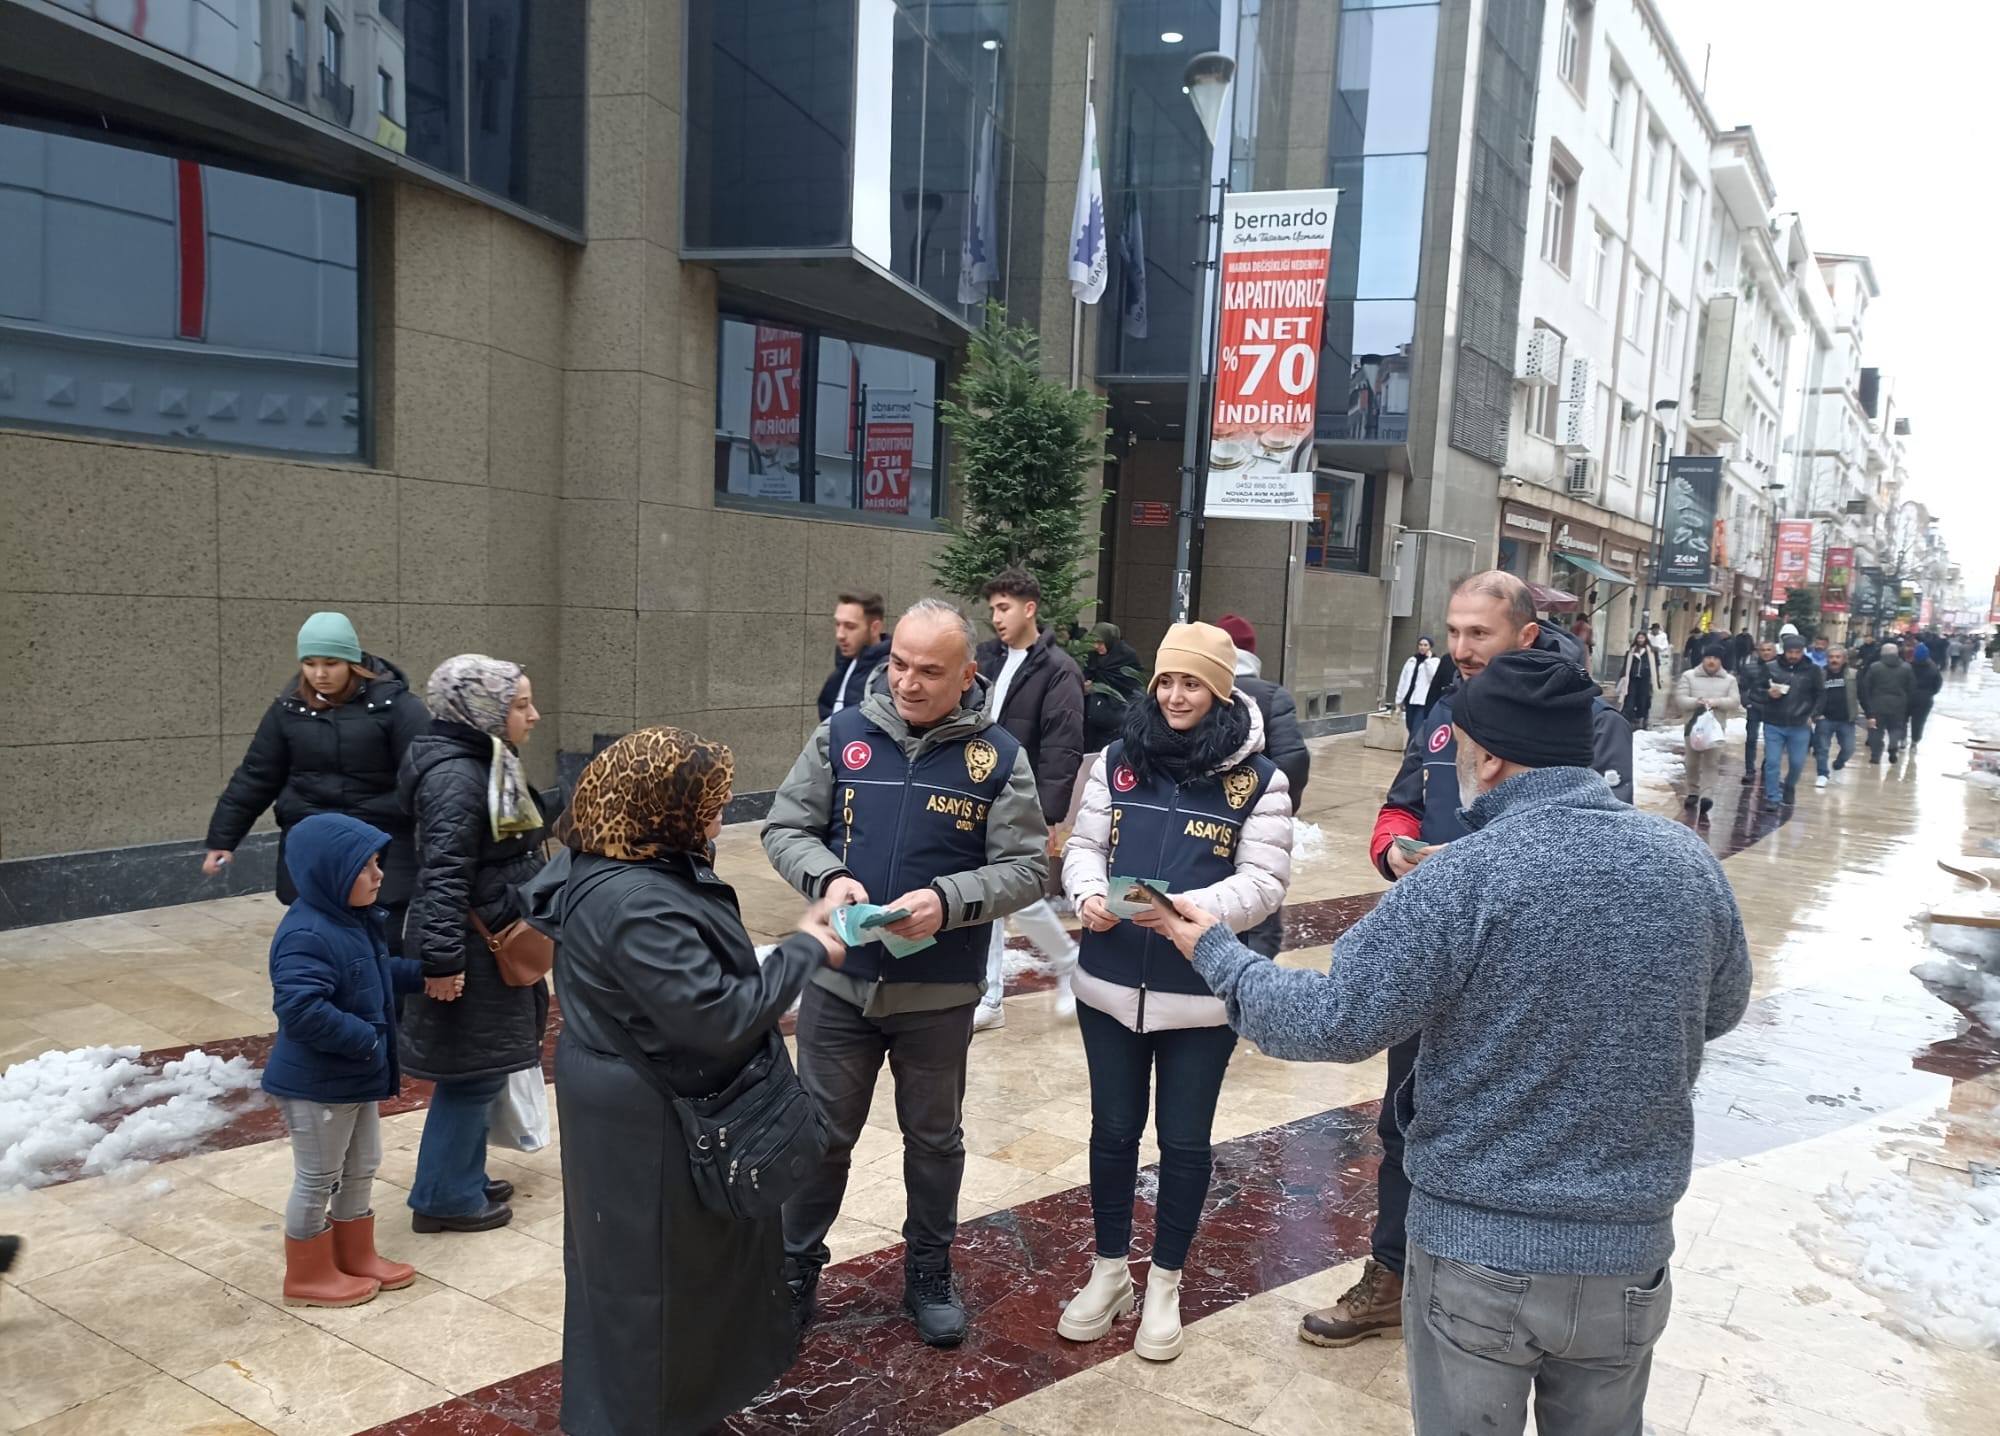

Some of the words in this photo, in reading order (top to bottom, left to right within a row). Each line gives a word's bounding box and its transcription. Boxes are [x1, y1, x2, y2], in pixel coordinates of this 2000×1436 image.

[1234, 208, 1328, 230] bernardo
[1224, 278, 1326, 311] KAPATIYORUZ
[1244, 317, 1312, 341] NET
[1218, 399, 1312, 425] İNDİRİM
[1674, 554, 1699, 563] ZEN
[926, 794, 973, 820] ASAYİŞ
[1183, 819, 1233, 846] ASAYİŞ
